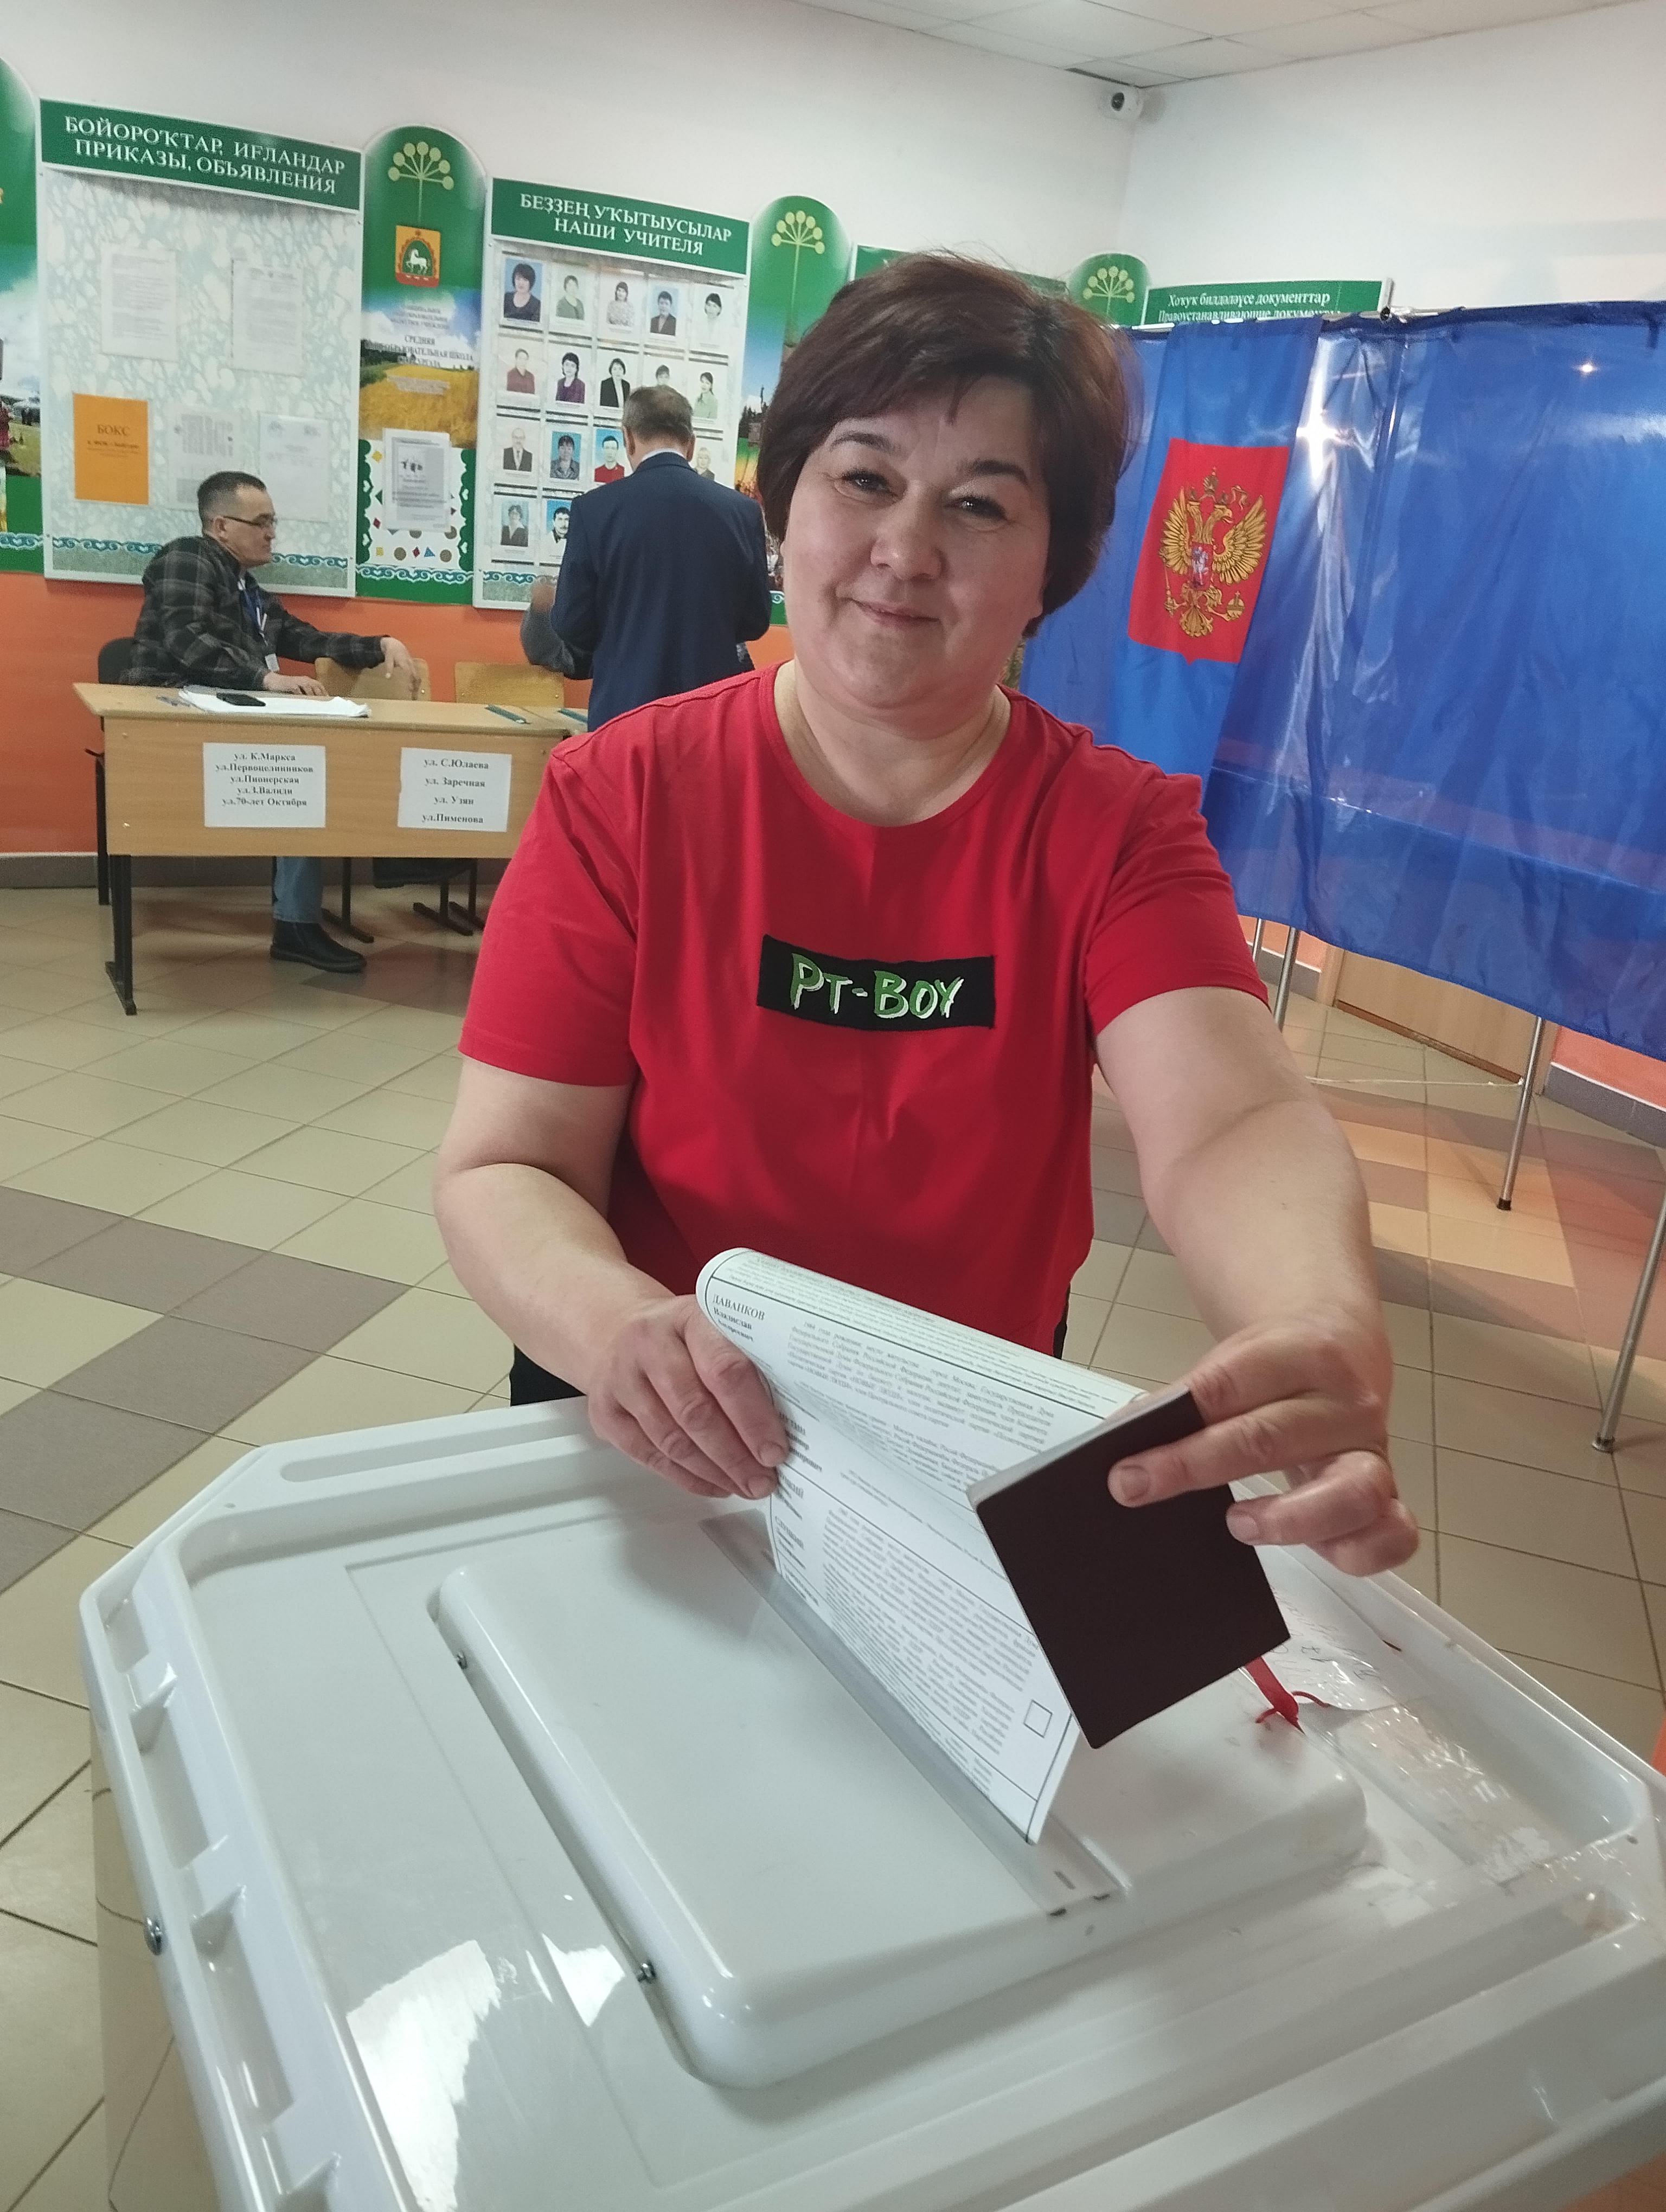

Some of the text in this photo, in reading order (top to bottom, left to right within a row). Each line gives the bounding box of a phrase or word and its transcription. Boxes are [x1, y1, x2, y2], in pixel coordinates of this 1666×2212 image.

[196, 156, 336, 194] ОБЪЯВЛЕНИЯ
[554, 217, 704, 256] НАШИ УЧИТЕЛЯ
[234, 753, 296, 763] ул. К.Маркса
[424, 758, 489, 769] ул. С.Юлаева
[443, 777, 485, 788] Заречная
[267, 798, 307, 807] Октября
[713, 1294, 765, 1321] ДАВАНКОВ
